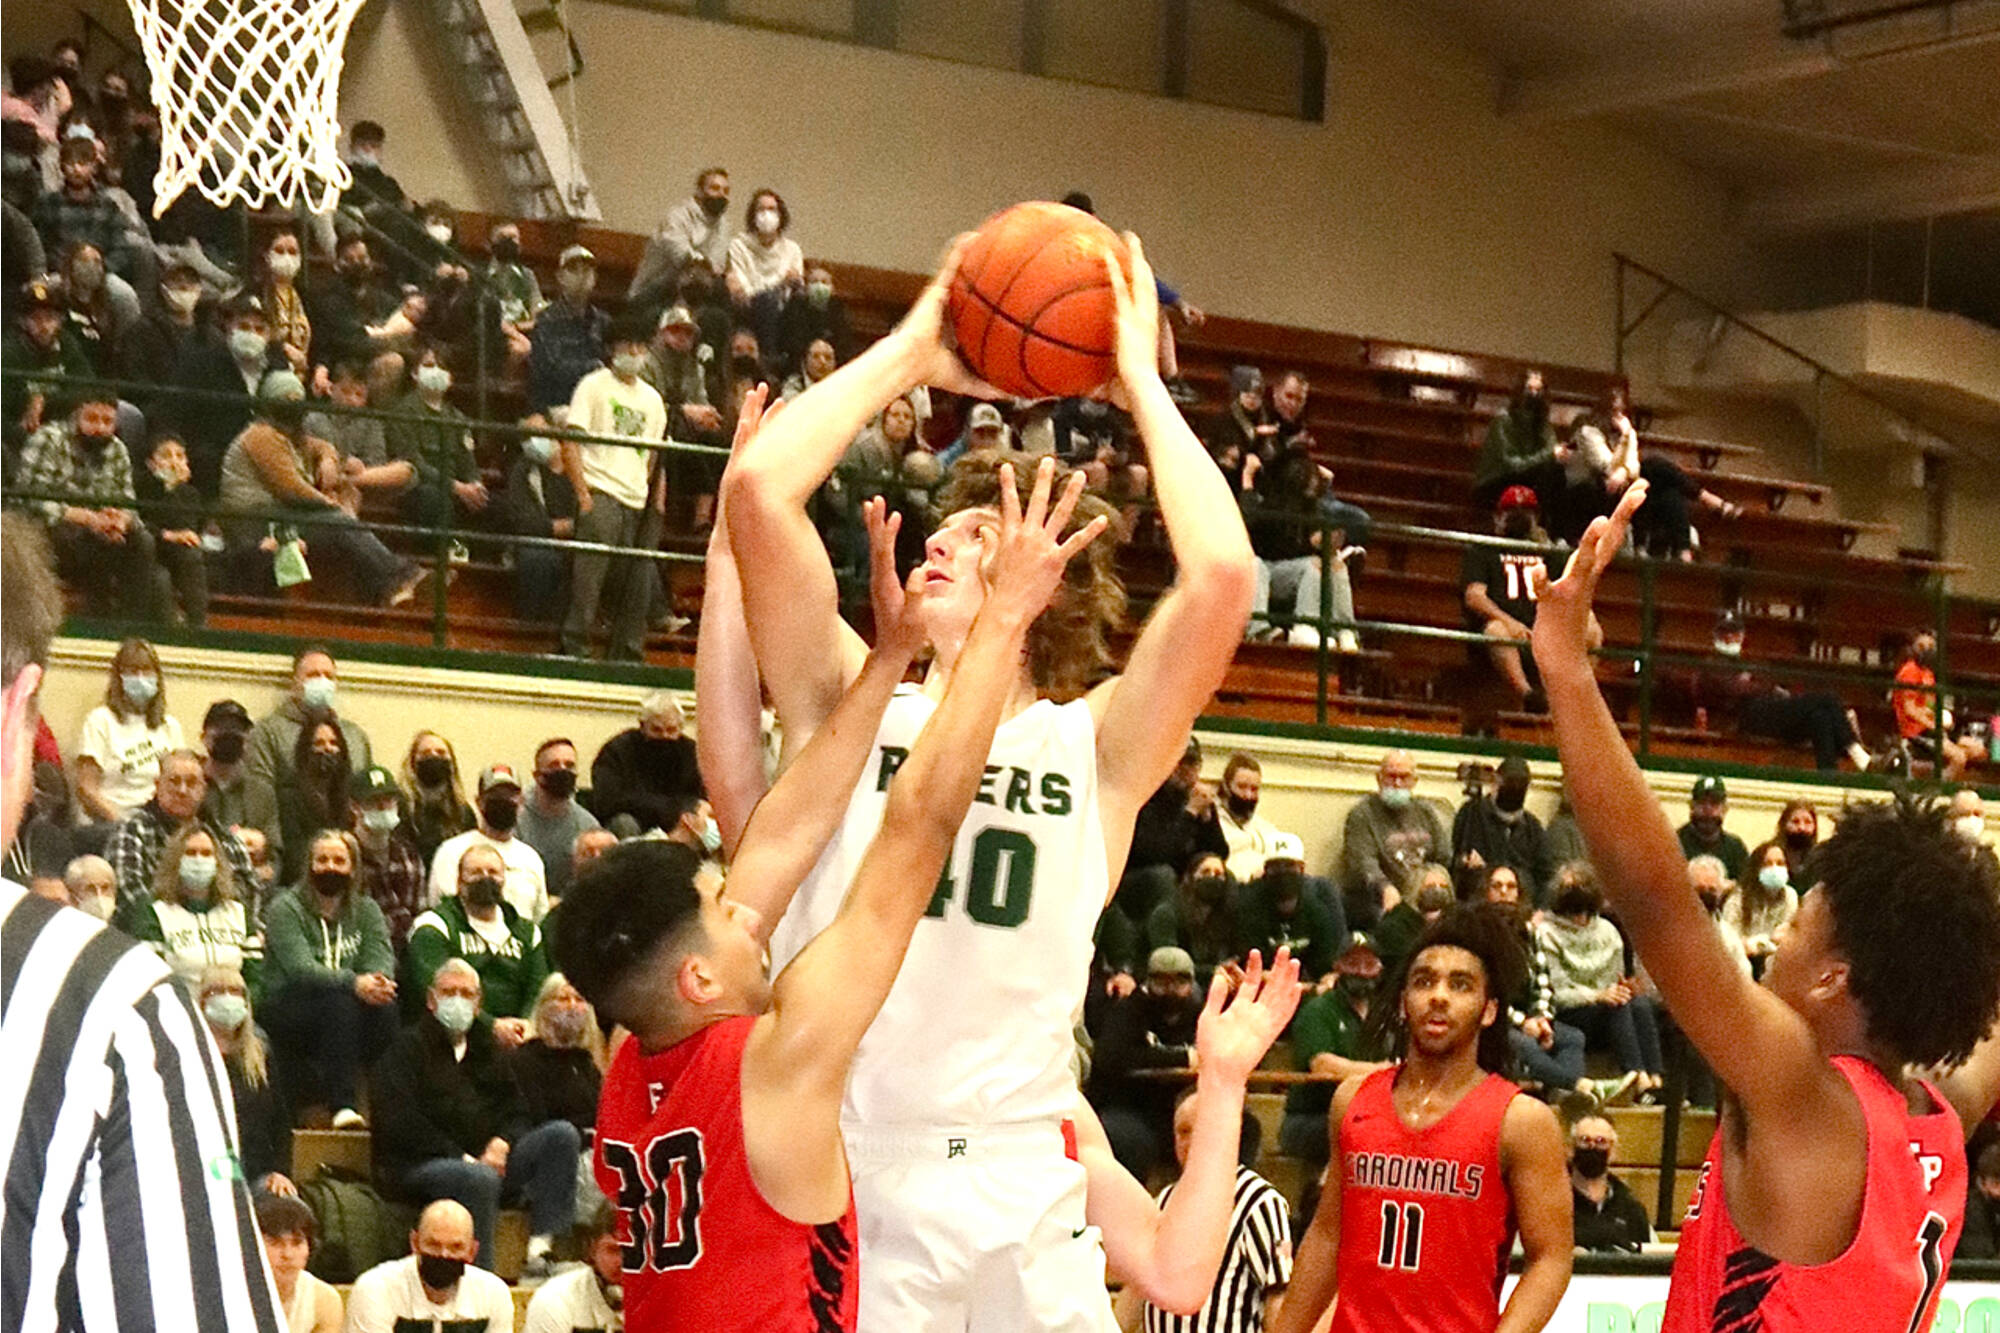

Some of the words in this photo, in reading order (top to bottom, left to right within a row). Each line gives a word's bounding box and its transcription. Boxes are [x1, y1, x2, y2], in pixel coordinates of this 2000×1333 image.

[876, 745, 1072, 816] RERS
[601, 1127, 704, 1273] 30
[1910, 1142, 1943, 1193] P
[1377, 1200, 1424, 1271] 11
